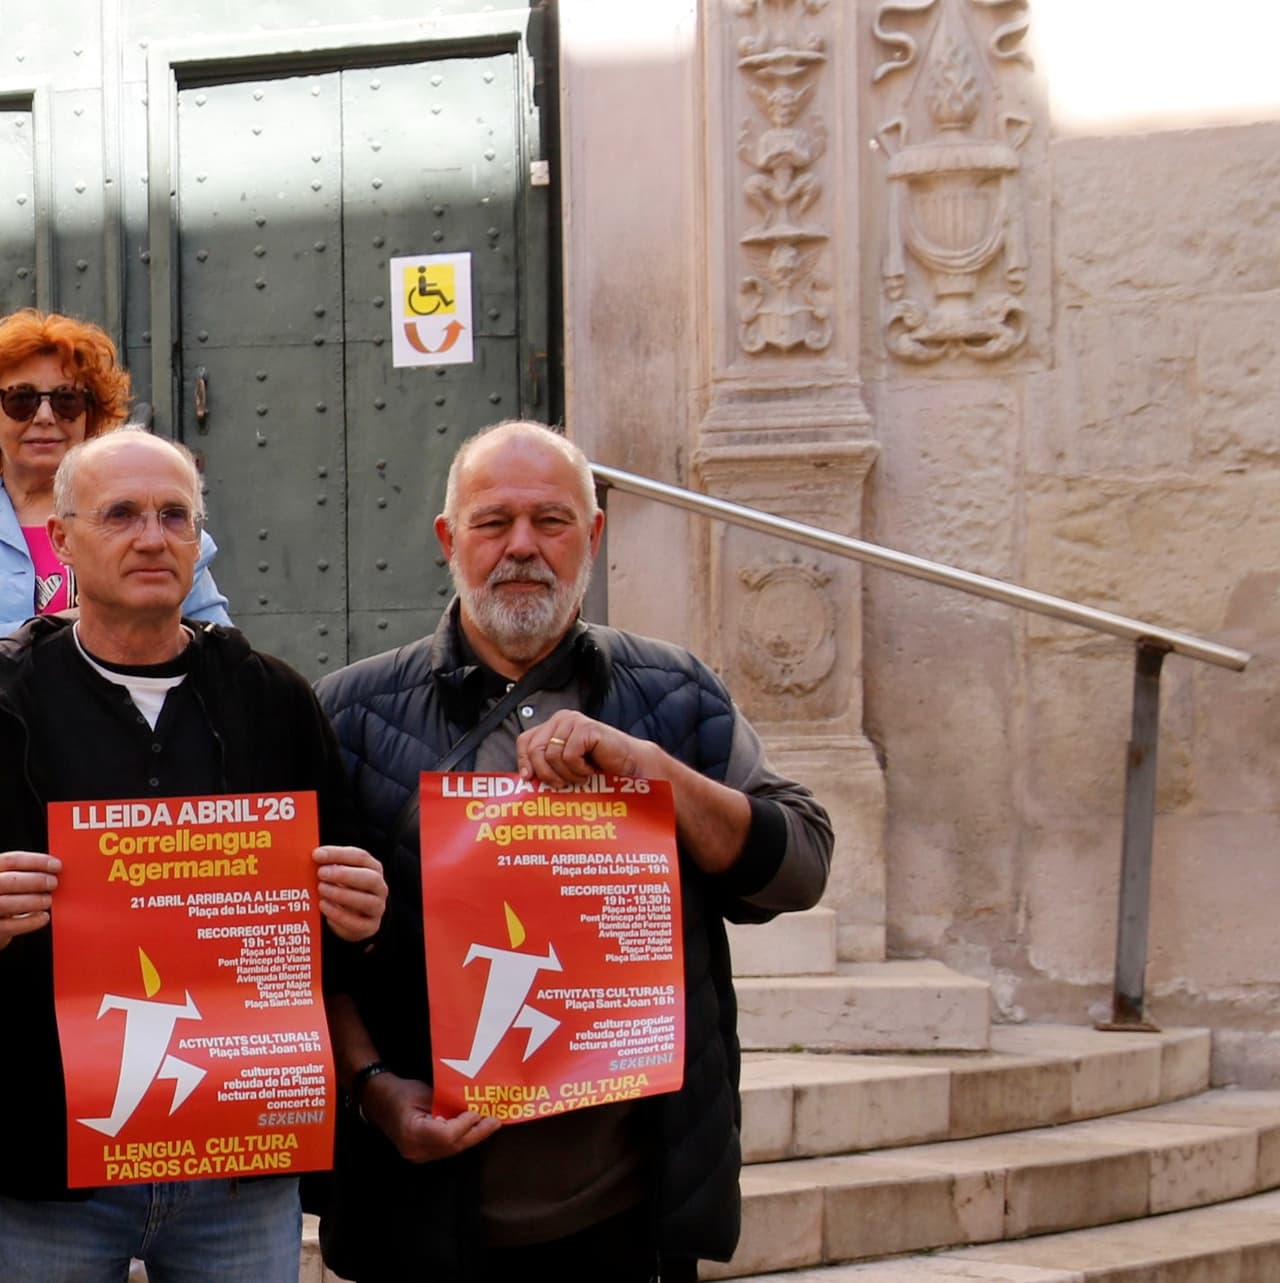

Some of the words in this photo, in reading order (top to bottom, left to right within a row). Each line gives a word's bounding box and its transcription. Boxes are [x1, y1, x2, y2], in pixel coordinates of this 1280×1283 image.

[442, 776, 536, 797] LLEIDA
[72, 802, 174, 830] LLEIDA
[466, 797, 627, 823] Correllengua
[98, 829, 272, 856] Correllengua
[476, 821, 616, 846] Agermanat
[108, 854, 258, 886] Agermanat
[131, 898, 145, 908] 21
[148, 895, 184, 908] ABRIL
[186, 892, 252, 906] ARRIBADA
[254, 892, 263, 902] A
[266, 889, 309, 902] LLEIDA
[198, 926, 276, 940] RECORREGUT
[278, 921, 310, 934] URBÀ
[537, 988, 605, 999] ACTIVITATS
[606, 985, 674, 998] CULTURALS
[179, 1036, 248, 1049] ACTIVITATS
[250, 1032, 319, 1045] CULTURALS
[464, 1085, 550, 1102] LLENGUA
[560, 1073, 648, 1098] CULTURA
[104, 1140, 196, 1162] LLENGUA
[206, 1133, 298, 1155] CULTURA
[184, 1152, 292, 1175] CATALANS
